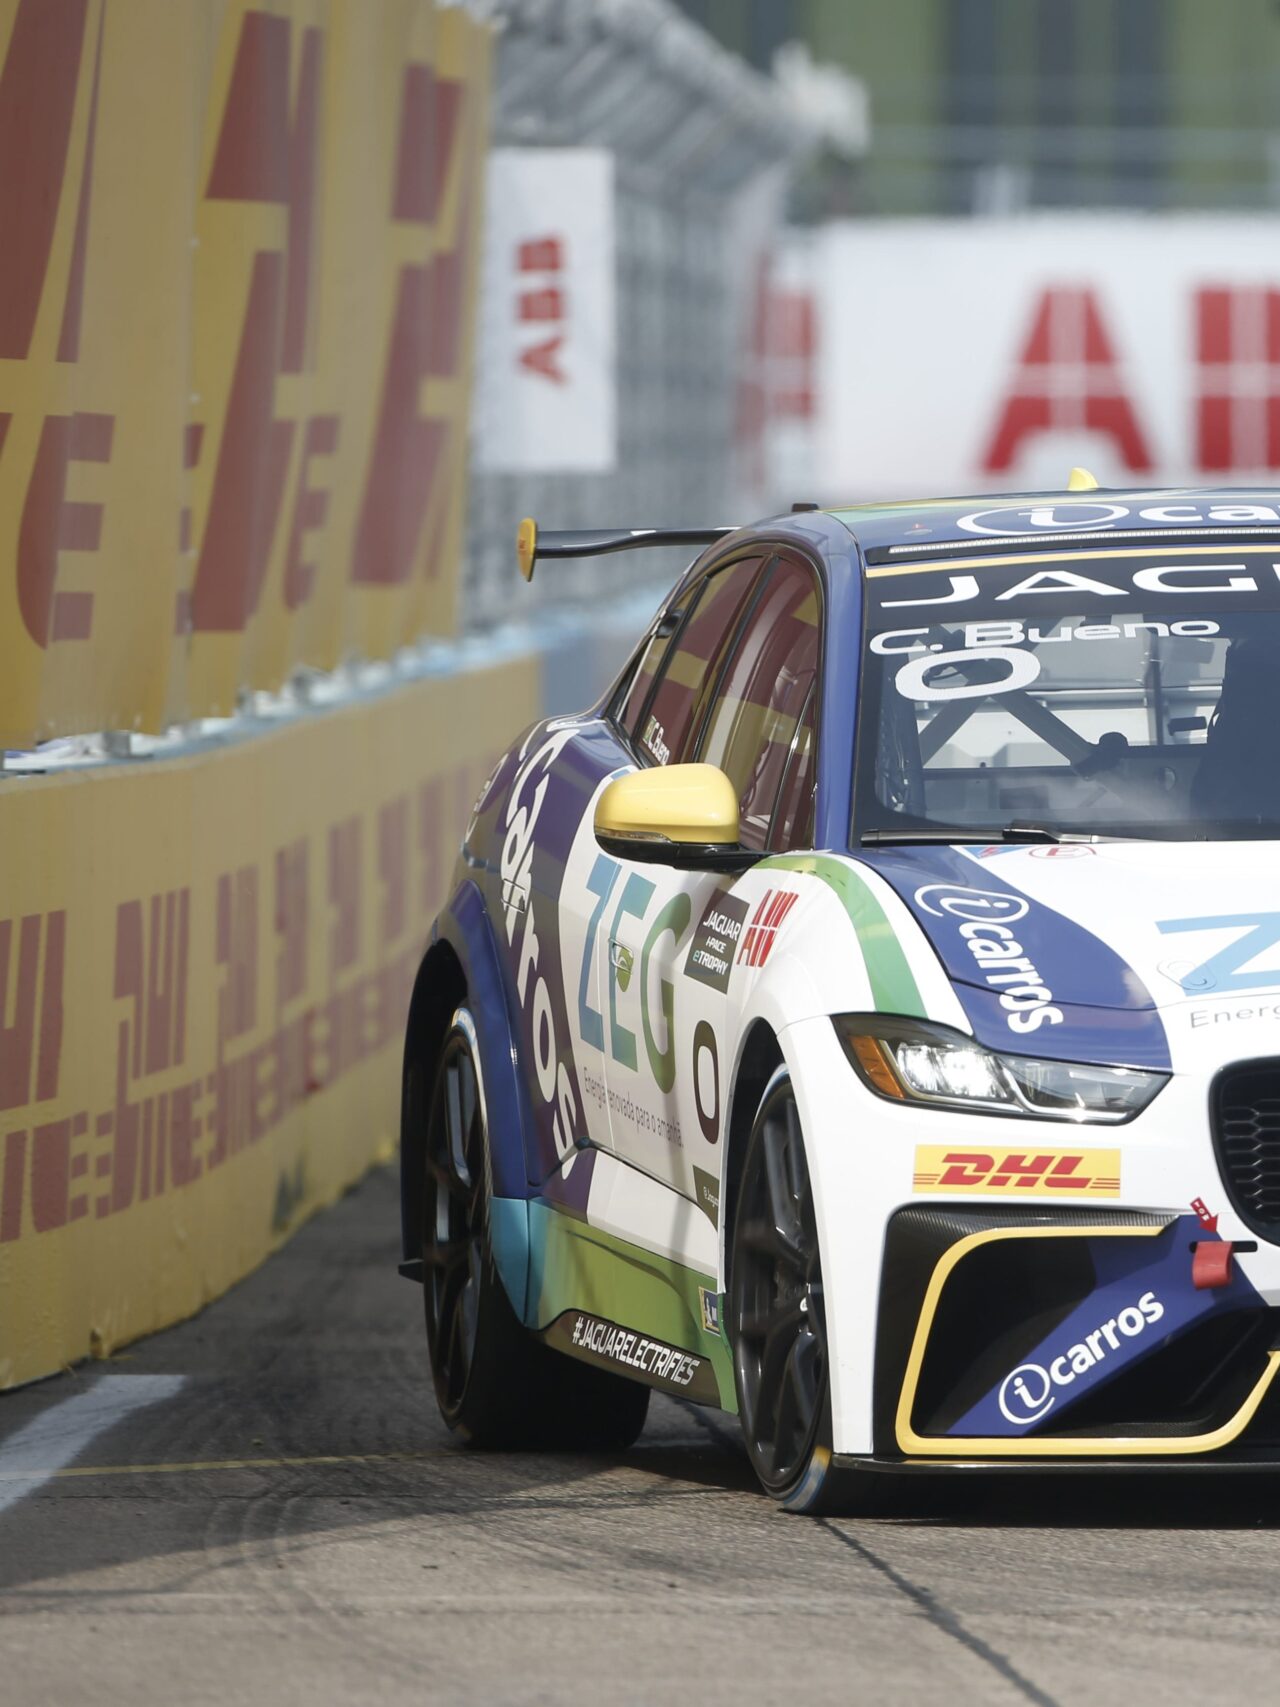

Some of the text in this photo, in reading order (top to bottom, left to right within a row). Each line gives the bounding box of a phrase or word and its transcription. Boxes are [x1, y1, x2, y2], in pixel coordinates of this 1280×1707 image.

[516, 237, 567, 384] ABB
[869, 620, 1220, 657] C. Bueno
[703, 910, 741, 941] JAGUAR
[578, 853, 691, 1094] ZEG
[938, 1153, 1092, 1188] DHL
[572, 1316, 700, 1385] #JAGUARELECTRIFIES
